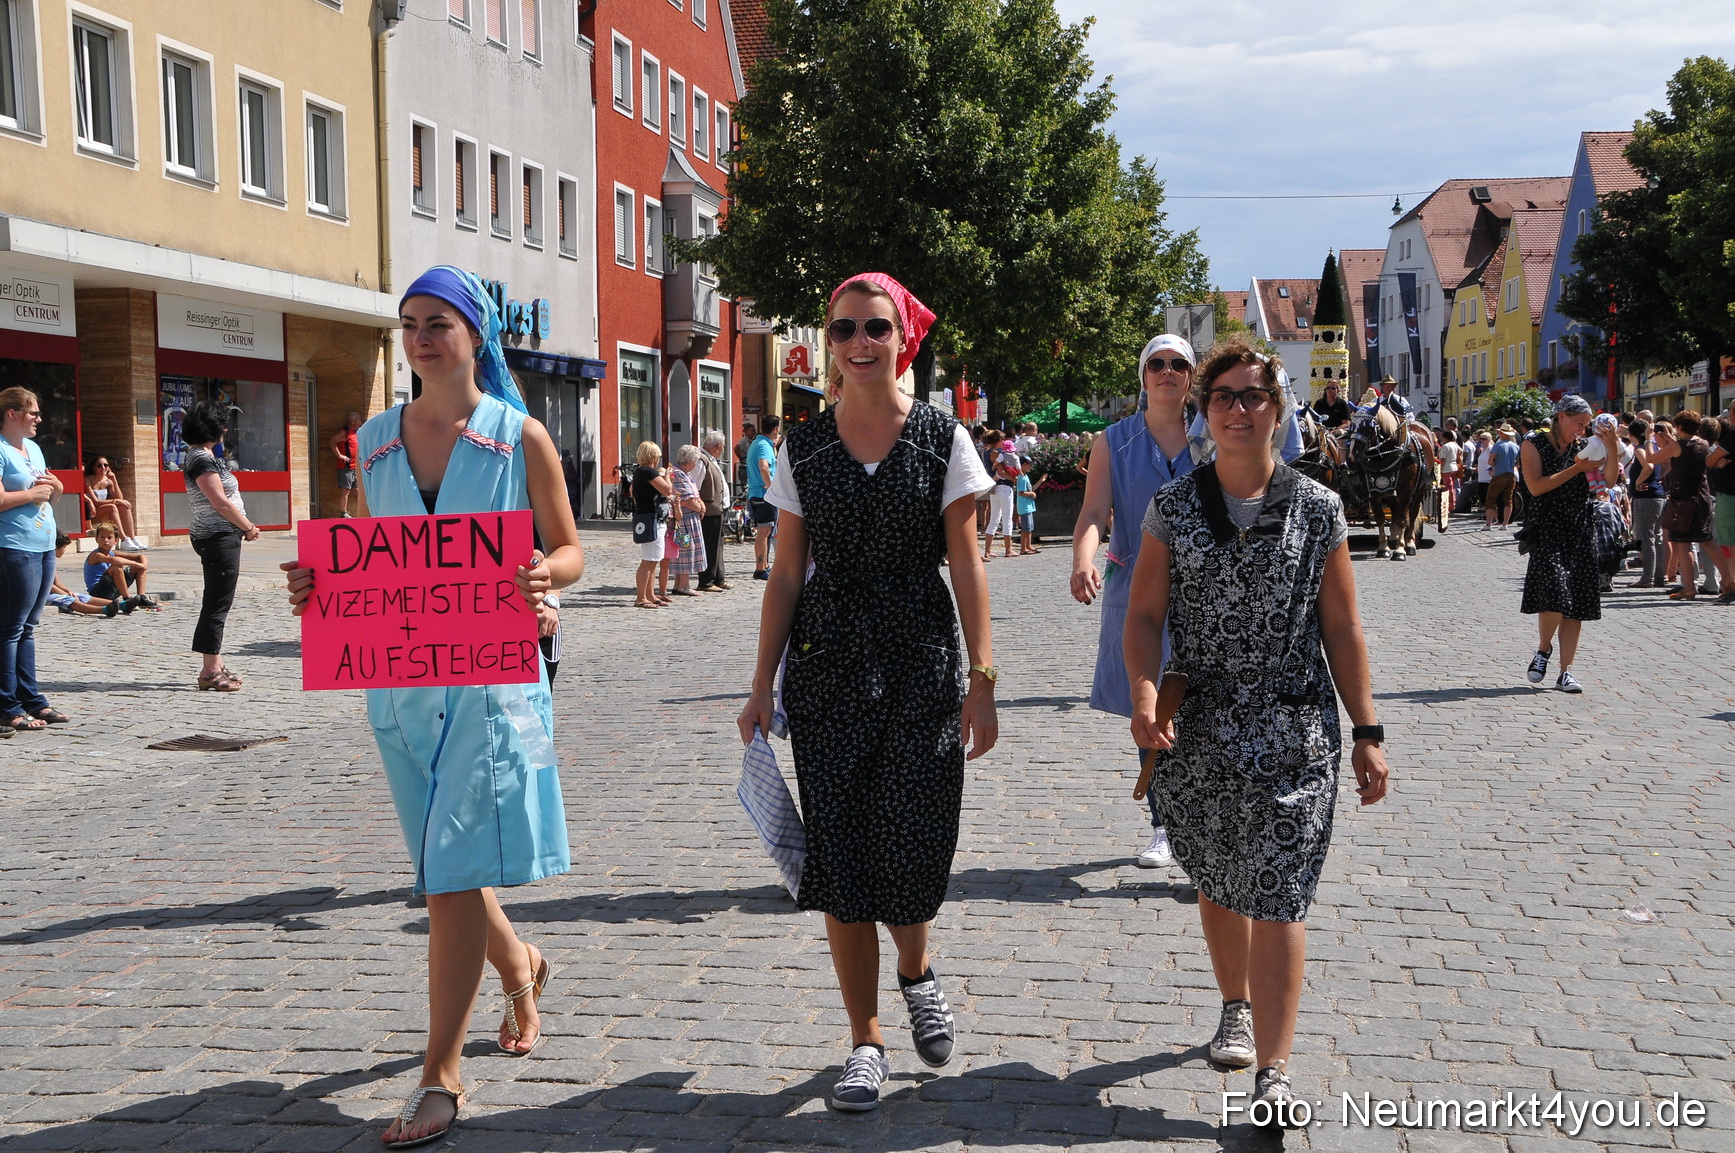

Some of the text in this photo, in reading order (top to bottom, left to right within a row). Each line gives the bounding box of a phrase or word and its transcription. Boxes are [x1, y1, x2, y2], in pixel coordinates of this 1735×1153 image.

[0, 283, 41, 299] er Optik
[16, 304, 59, 321] CENTRUM
[186, 310, 241, 329] Reissinger Optik
[223, 333, 254, 347] CENTRUM
[1464, 338, 1477, 351] HOTEL
[327, 515, 504, 575] DAMEN
[316, 580, 520, 619] VIZEMEISTER
